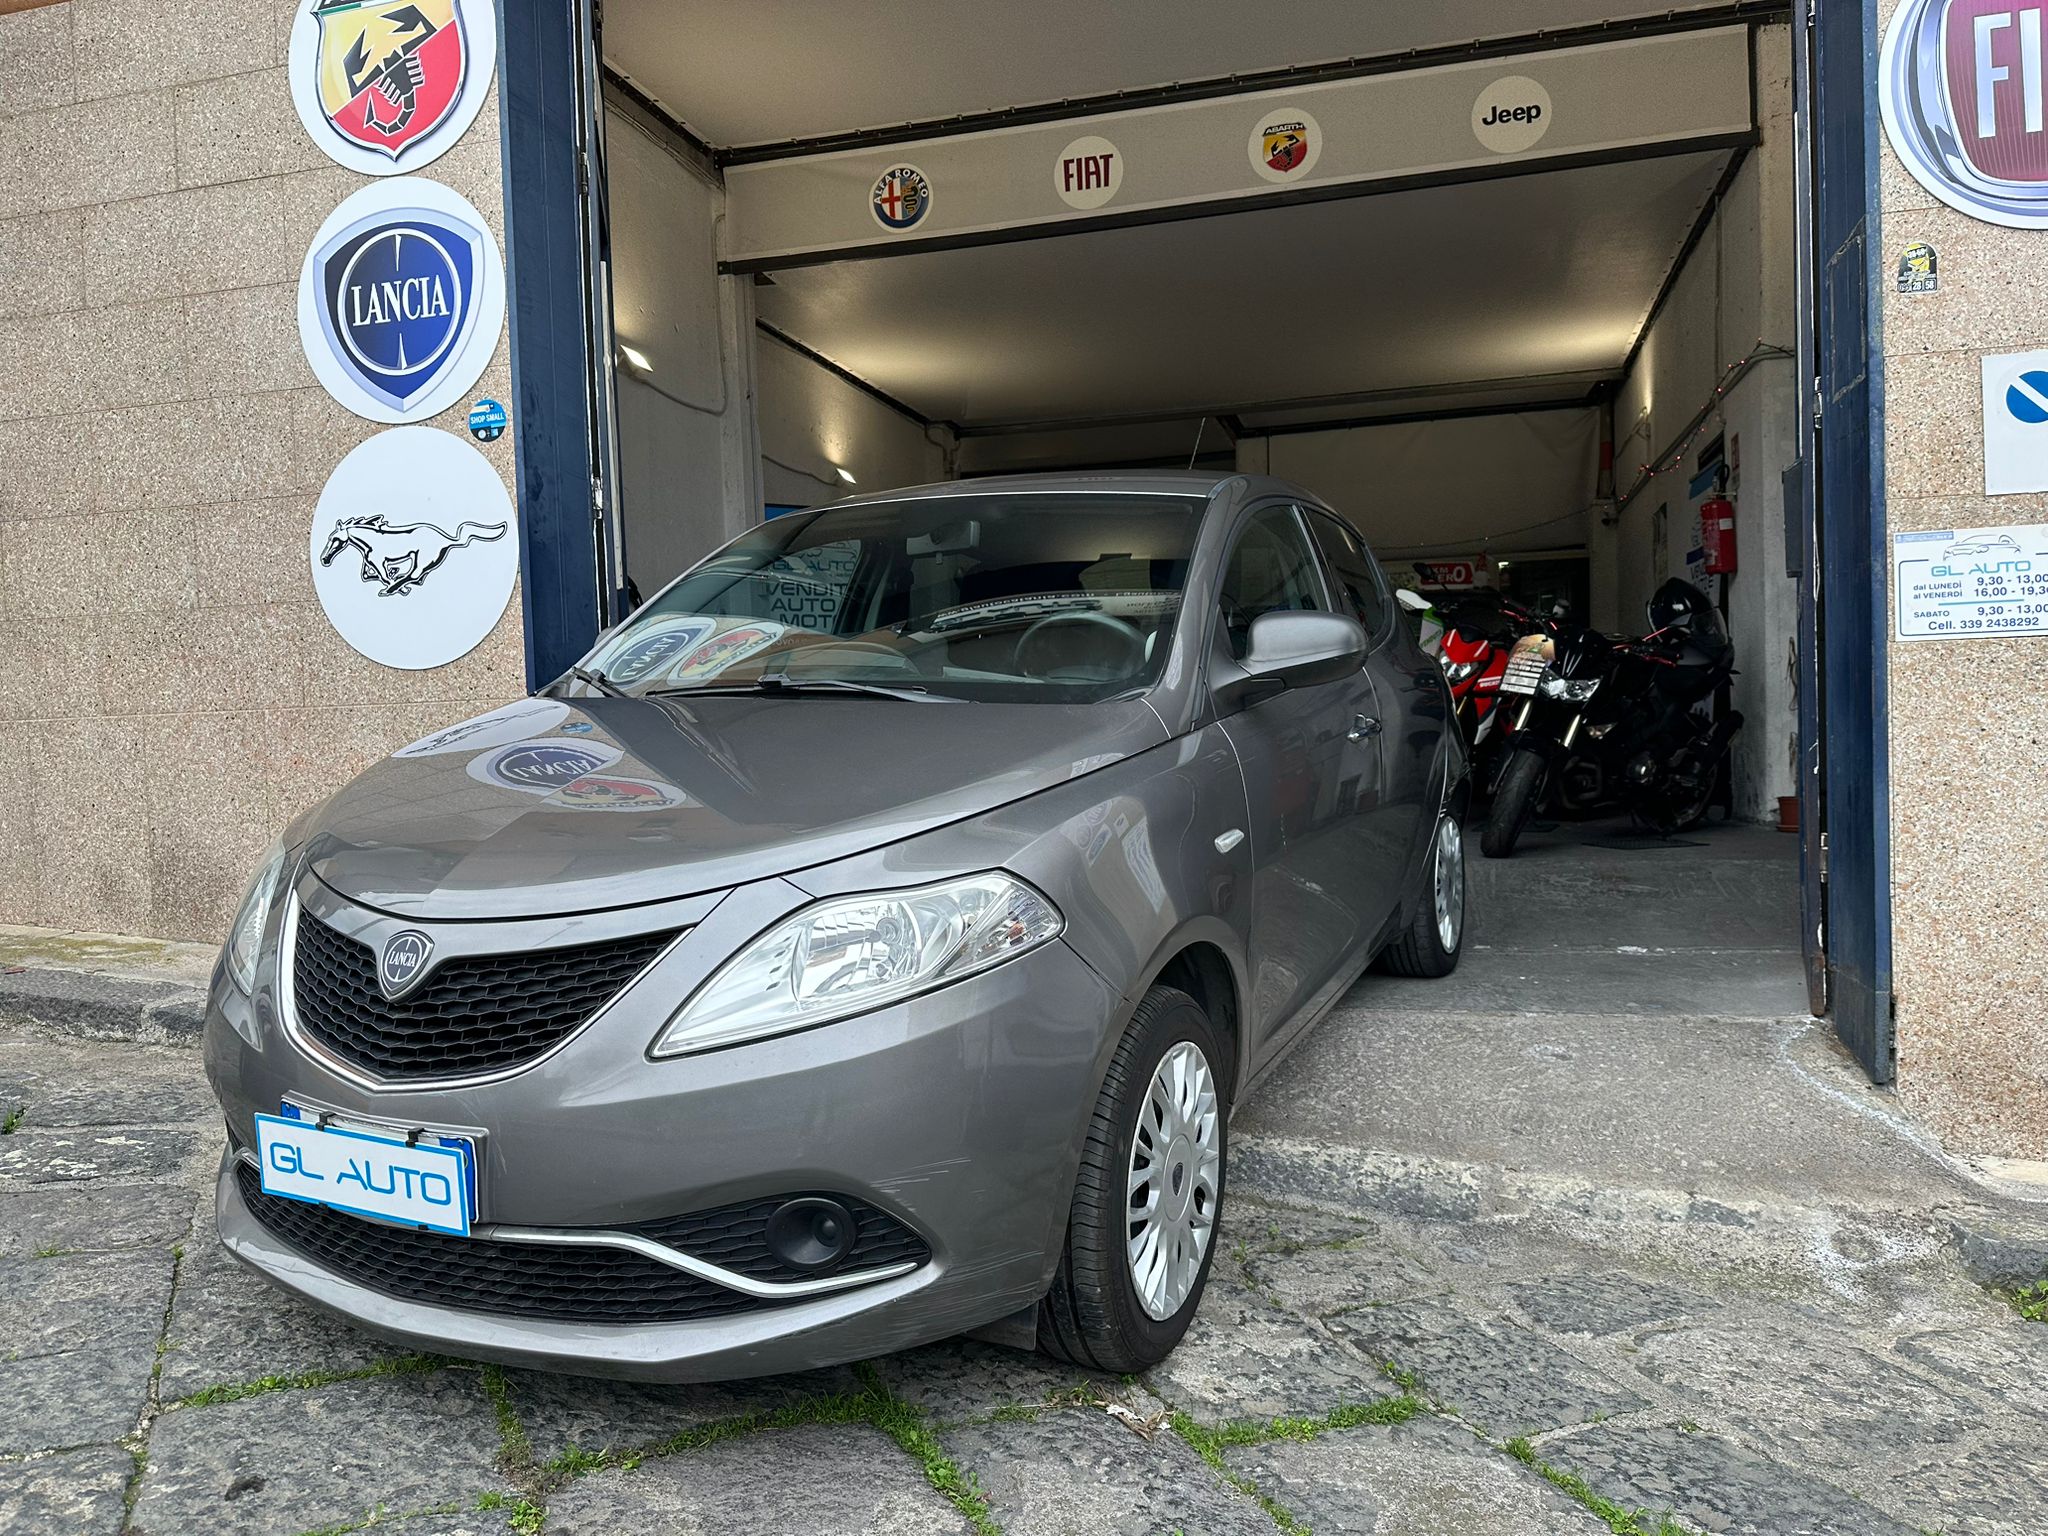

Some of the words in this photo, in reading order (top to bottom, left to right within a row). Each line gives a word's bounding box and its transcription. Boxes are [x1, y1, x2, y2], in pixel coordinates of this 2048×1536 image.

[1482, 104, 1541, 126] Jeep
[1265, 123, 1304, 134] ABARTH
[1063, 153, 1114, 192] FIAT
[873, 175, 893, 205] ALFA
[894, 169, 928, 198] ROMEO
[350, 274, 450, 327] LANCIA
[470, 415, 486, 425] SHOP
[486, 412, 505, 422] SMALL
[1931, 565, 1964, 577] GL
[1968, 560, 2031, 575] AUTO
[1928, 580, 1962, 590] LUNEDÌ
[1977, 576, 2003, 587] 9,30
[1923, 591, 1963, 599] VENERDÌ
[1974, 587, 2007, 598] 16,00
[771, 598, 836, 613] AUTO
[1977, 606, 2004, 617] 9,30
[1913, 611, 1950, 619] SABATO
[1928, 620, 1956, 631] Cell.
[1960, 619, 1983, 629] 339
[1986, 616, 2040, 628] 2438292
[388, 950, 417, 967] LANCIA
[270, 1142, 324, 1181] GL
[336, 1158, 452, 1205] AUTO
